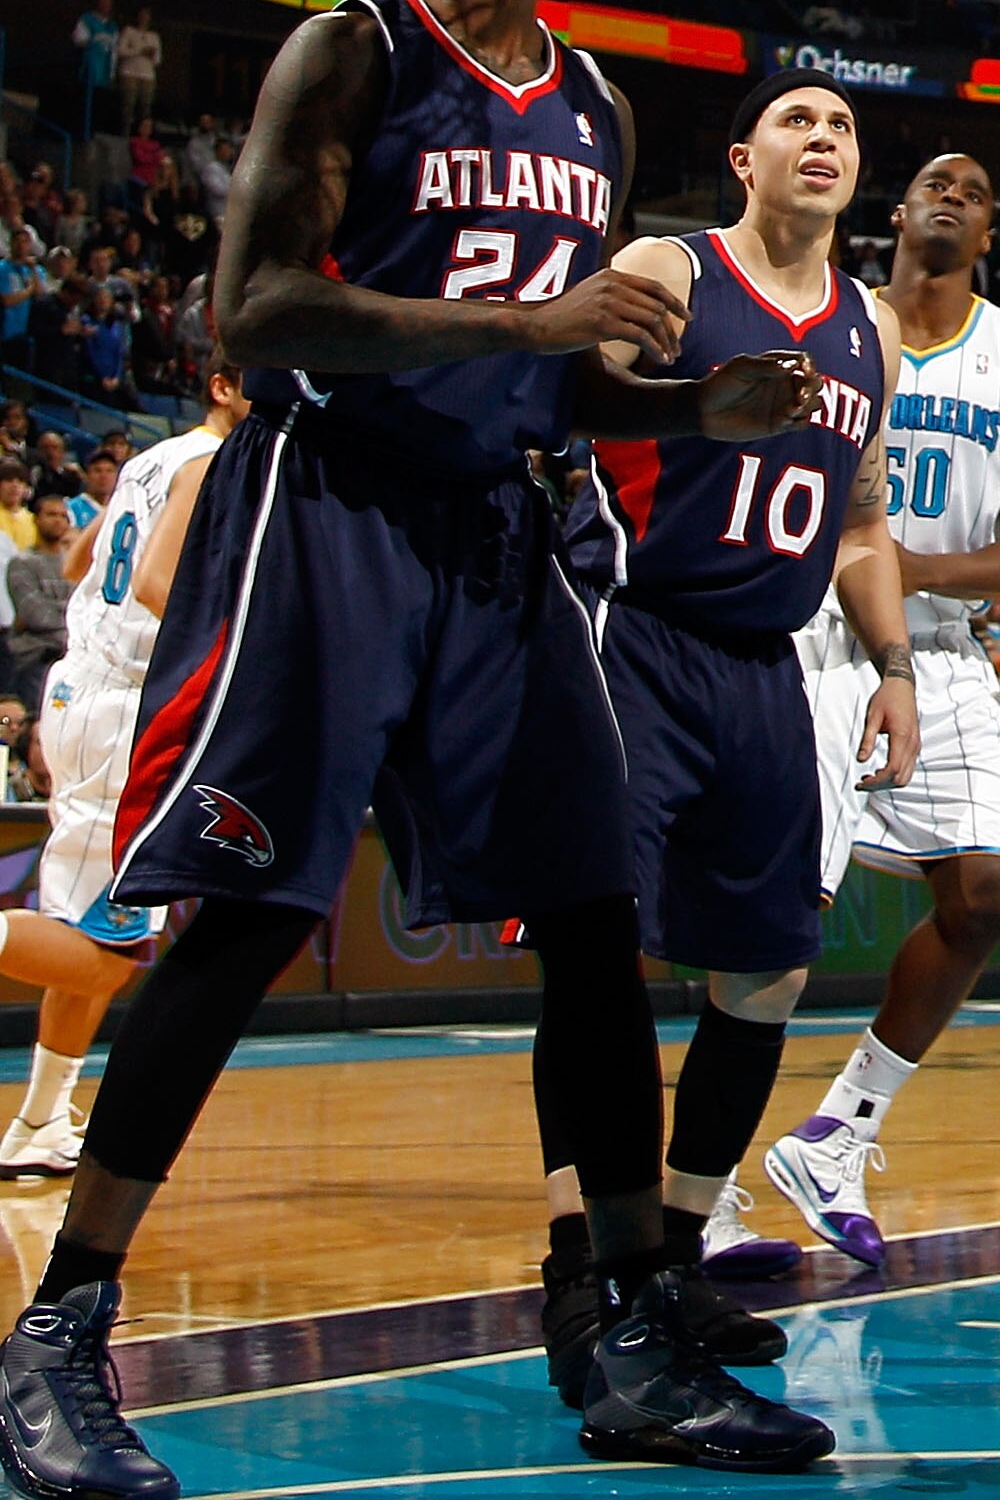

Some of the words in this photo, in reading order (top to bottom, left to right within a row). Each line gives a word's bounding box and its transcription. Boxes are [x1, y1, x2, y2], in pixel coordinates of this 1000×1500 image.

[795, 44, 915, 87] Ochsner
[413, 147, 612, 237] ATLANTA
[441, 227, 581, 302] 24
[719, 452, 828, 558] 10
[102, 510, 138, 605] 8
